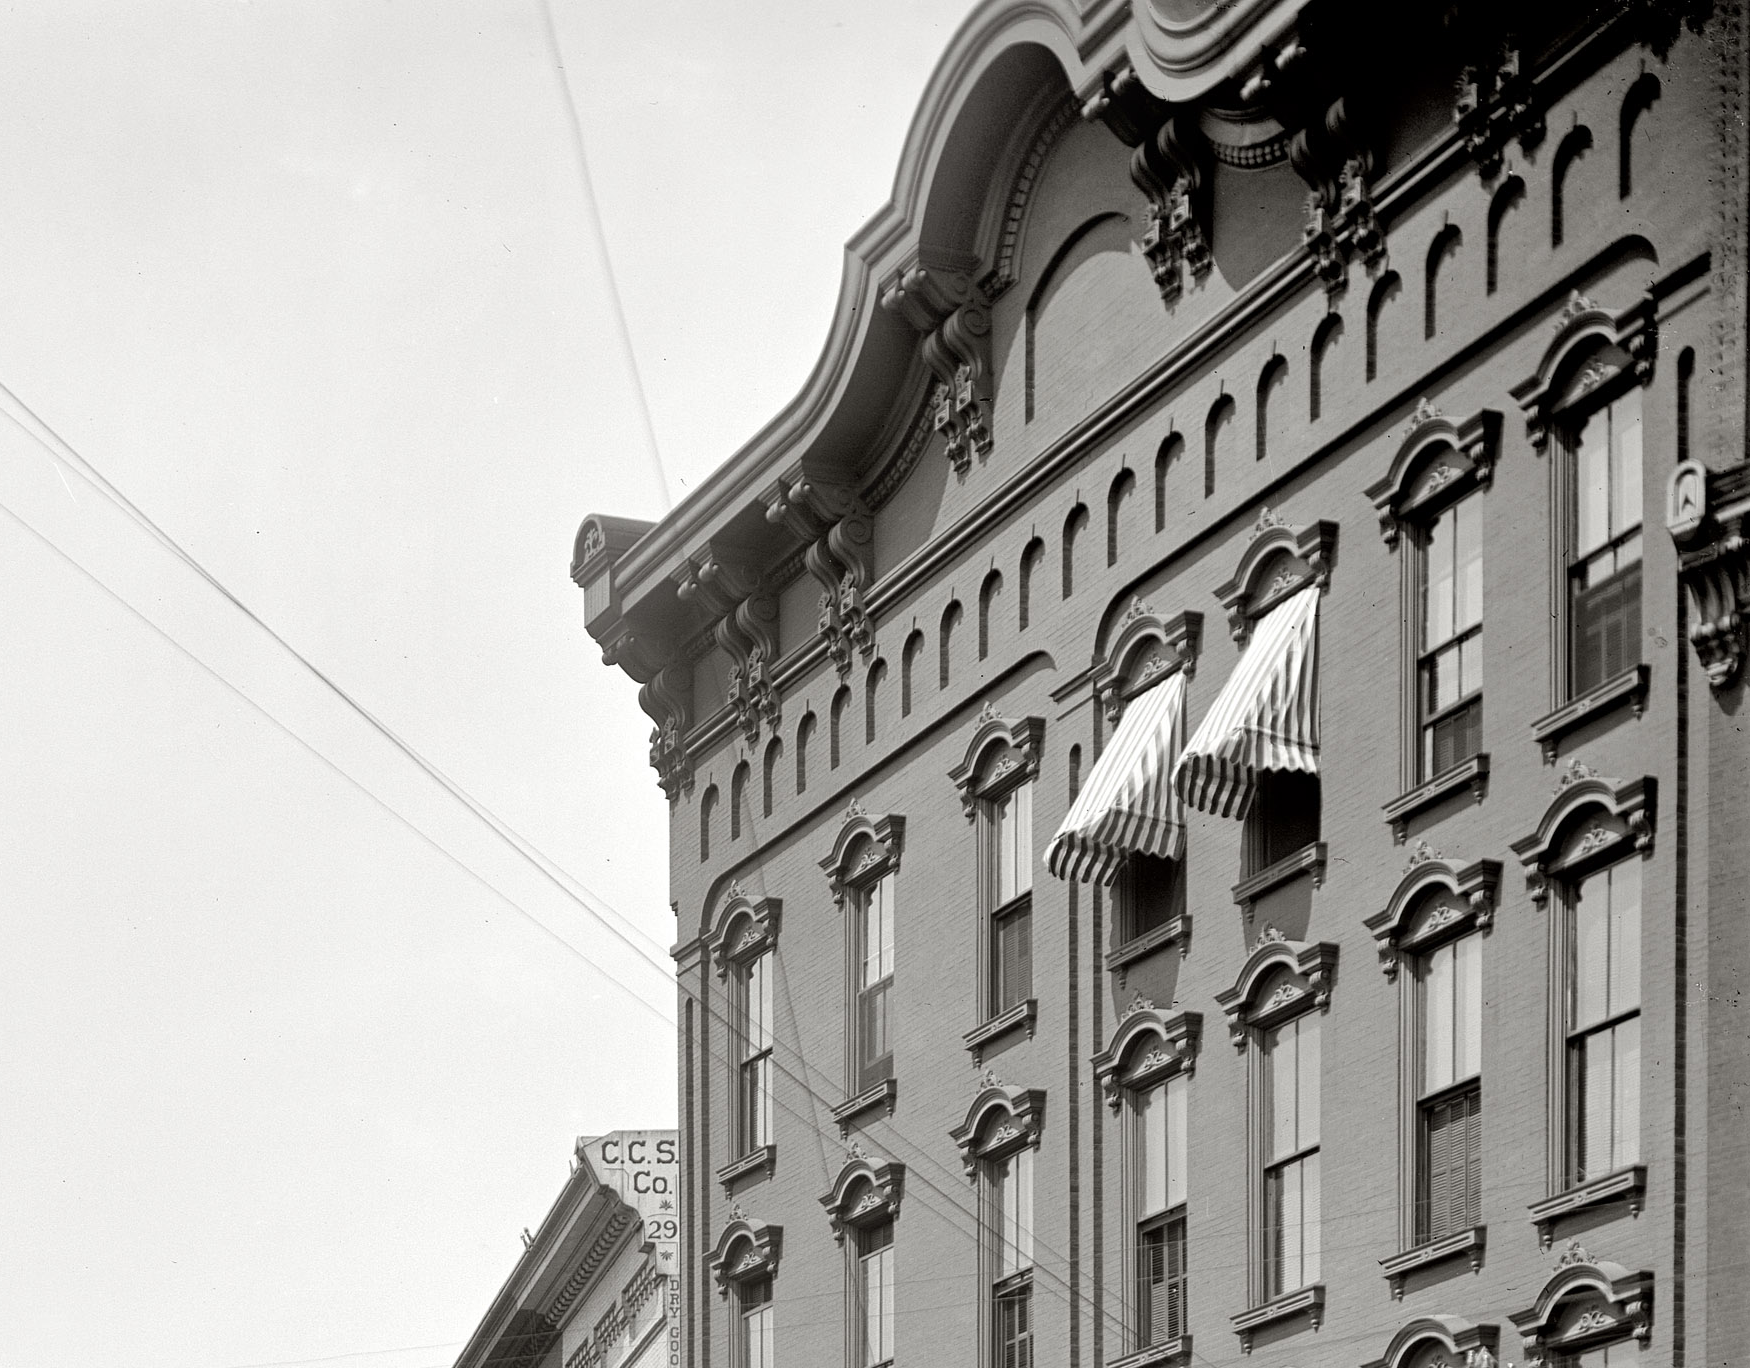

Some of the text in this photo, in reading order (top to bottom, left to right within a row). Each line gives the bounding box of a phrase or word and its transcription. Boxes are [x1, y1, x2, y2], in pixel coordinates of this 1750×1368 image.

[634, 1170, 673, 1194] Co.
[647, 1220, 678, 1239] 29
[669, 1279, 680, 1319] DRY
